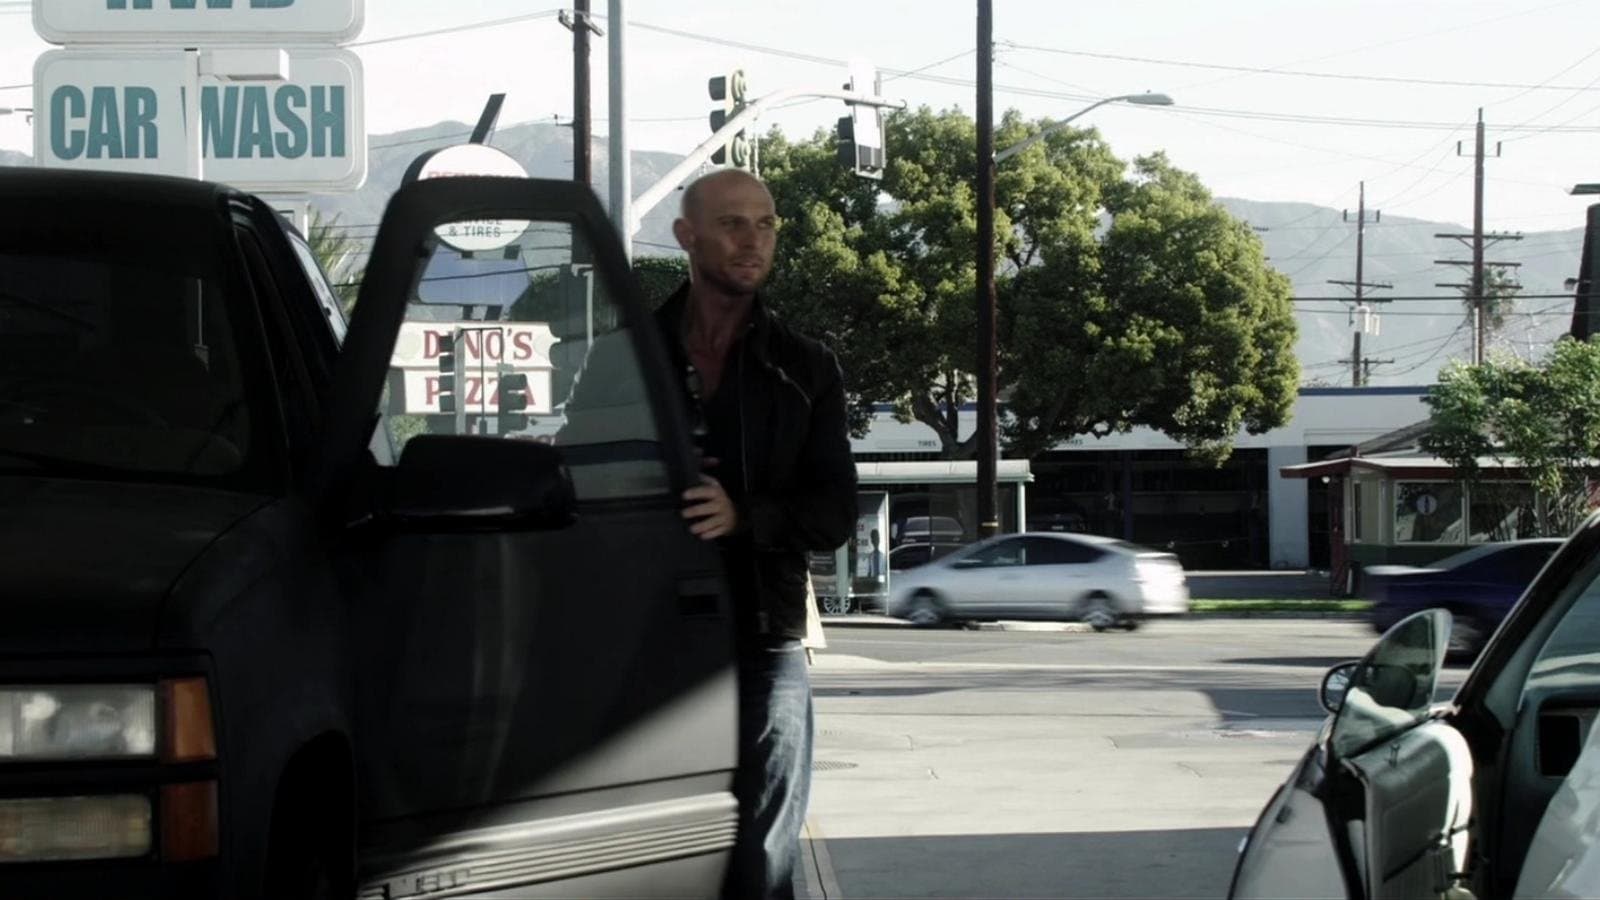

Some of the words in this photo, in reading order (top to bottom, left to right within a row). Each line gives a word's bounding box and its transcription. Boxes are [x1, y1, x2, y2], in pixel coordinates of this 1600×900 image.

[50, 84, 158, 160] CAR
[181, 84, 346, 159] WASH
[448, 225, 458, 237] &
[463, 225, 501, 238] TIRES
[423, 328, 533, 361] DNO'S
